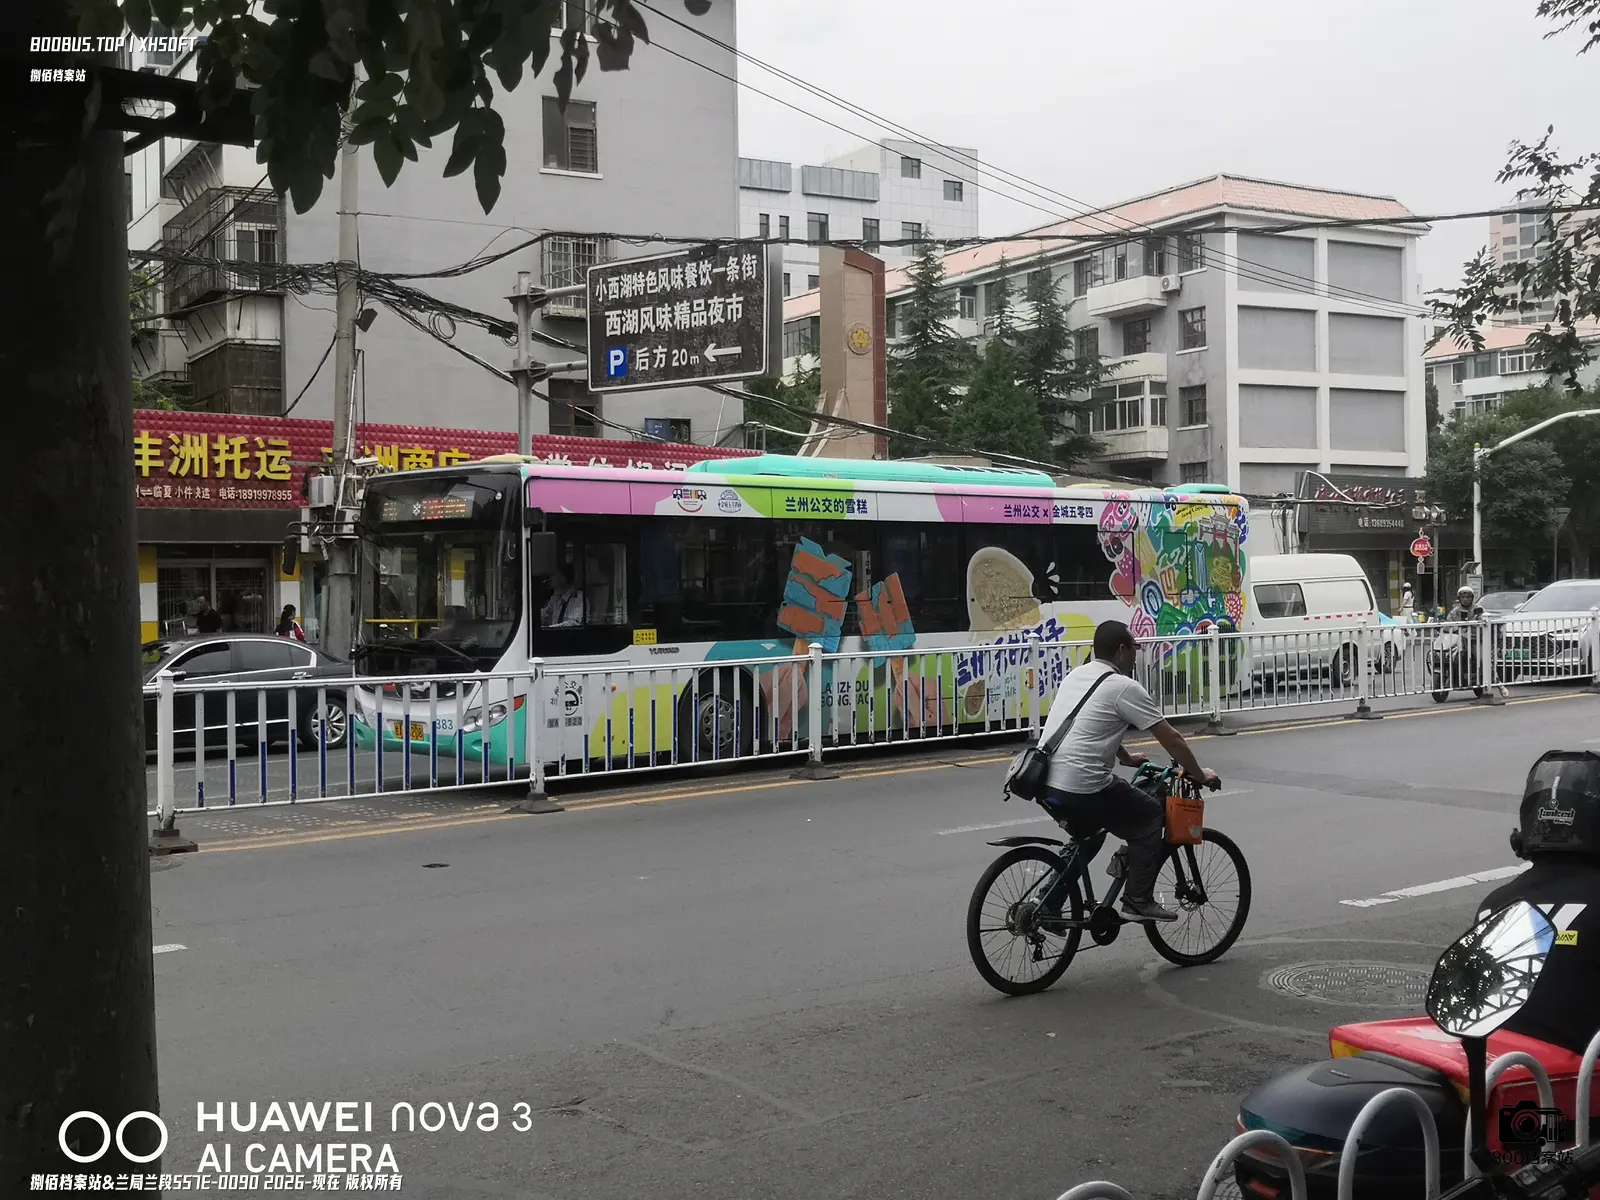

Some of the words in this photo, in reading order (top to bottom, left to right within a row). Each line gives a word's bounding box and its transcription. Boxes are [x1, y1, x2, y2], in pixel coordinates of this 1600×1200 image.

[595, 253, 758, 303] 小西湖特色风味餐饮一条街
[604, 292, 744, 338] 西湖风味精品夜市
[635, 345, 668, 372] 后方
[784, 496, 868, 515] 兰州公交的雪糕
[1003, 503, 1040, 519] 兰州公交
[1051, 504, 1094, 519] 金城五零四
